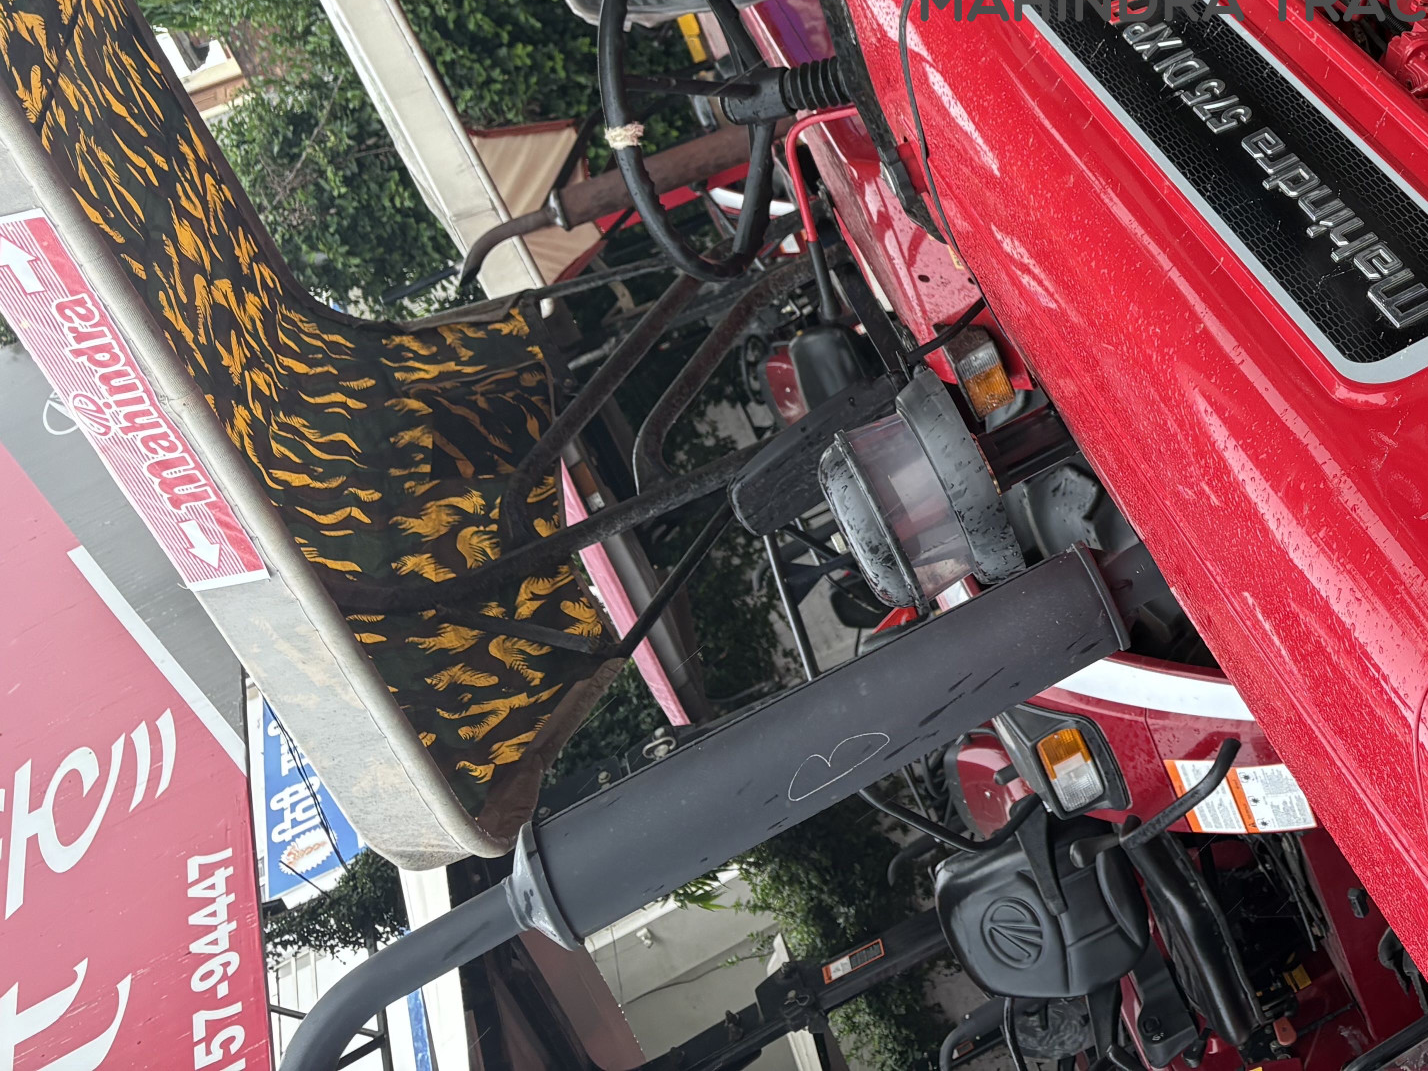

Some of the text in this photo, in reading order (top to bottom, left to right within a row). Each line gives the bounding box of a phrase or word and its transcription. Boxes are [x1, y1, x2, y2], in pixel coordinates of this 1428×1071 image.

[1122, 19, 1184, 59] XP
[1153, 53, 1212, 89] DI
[1178, 77, 1252, 134] 575
[51, 295, 216, 513] mahindra
